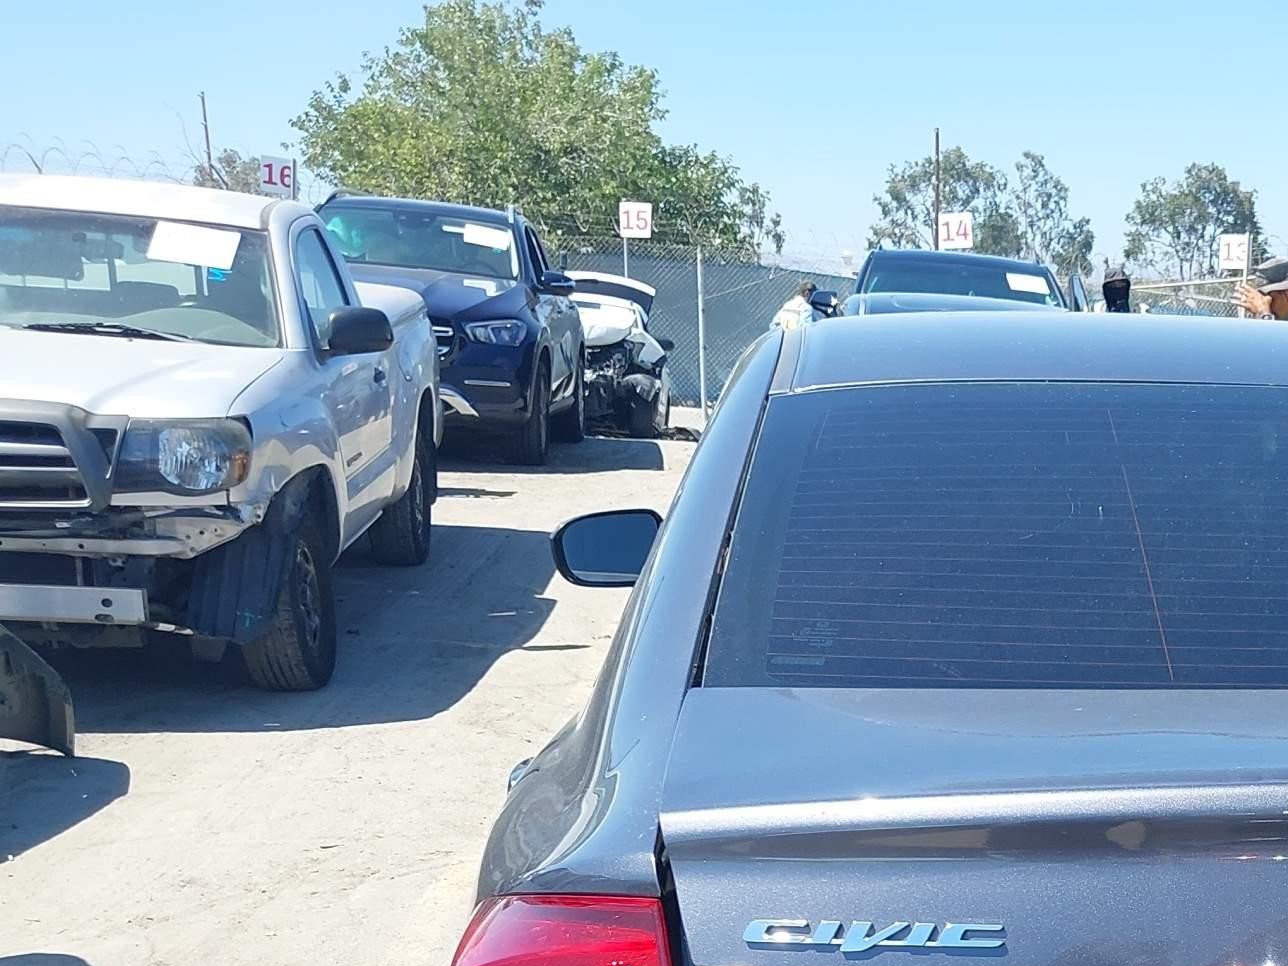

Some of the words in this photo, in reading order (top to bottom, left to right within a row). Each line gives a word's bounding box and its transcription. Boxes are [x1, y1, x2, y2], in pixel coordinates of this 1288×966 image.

[262, 163, 291, 188] 16
[622, 210, 648, 230] 15
[942, 220, 970, 241] 14
[743, 919, 1006, 952] CIVIC
